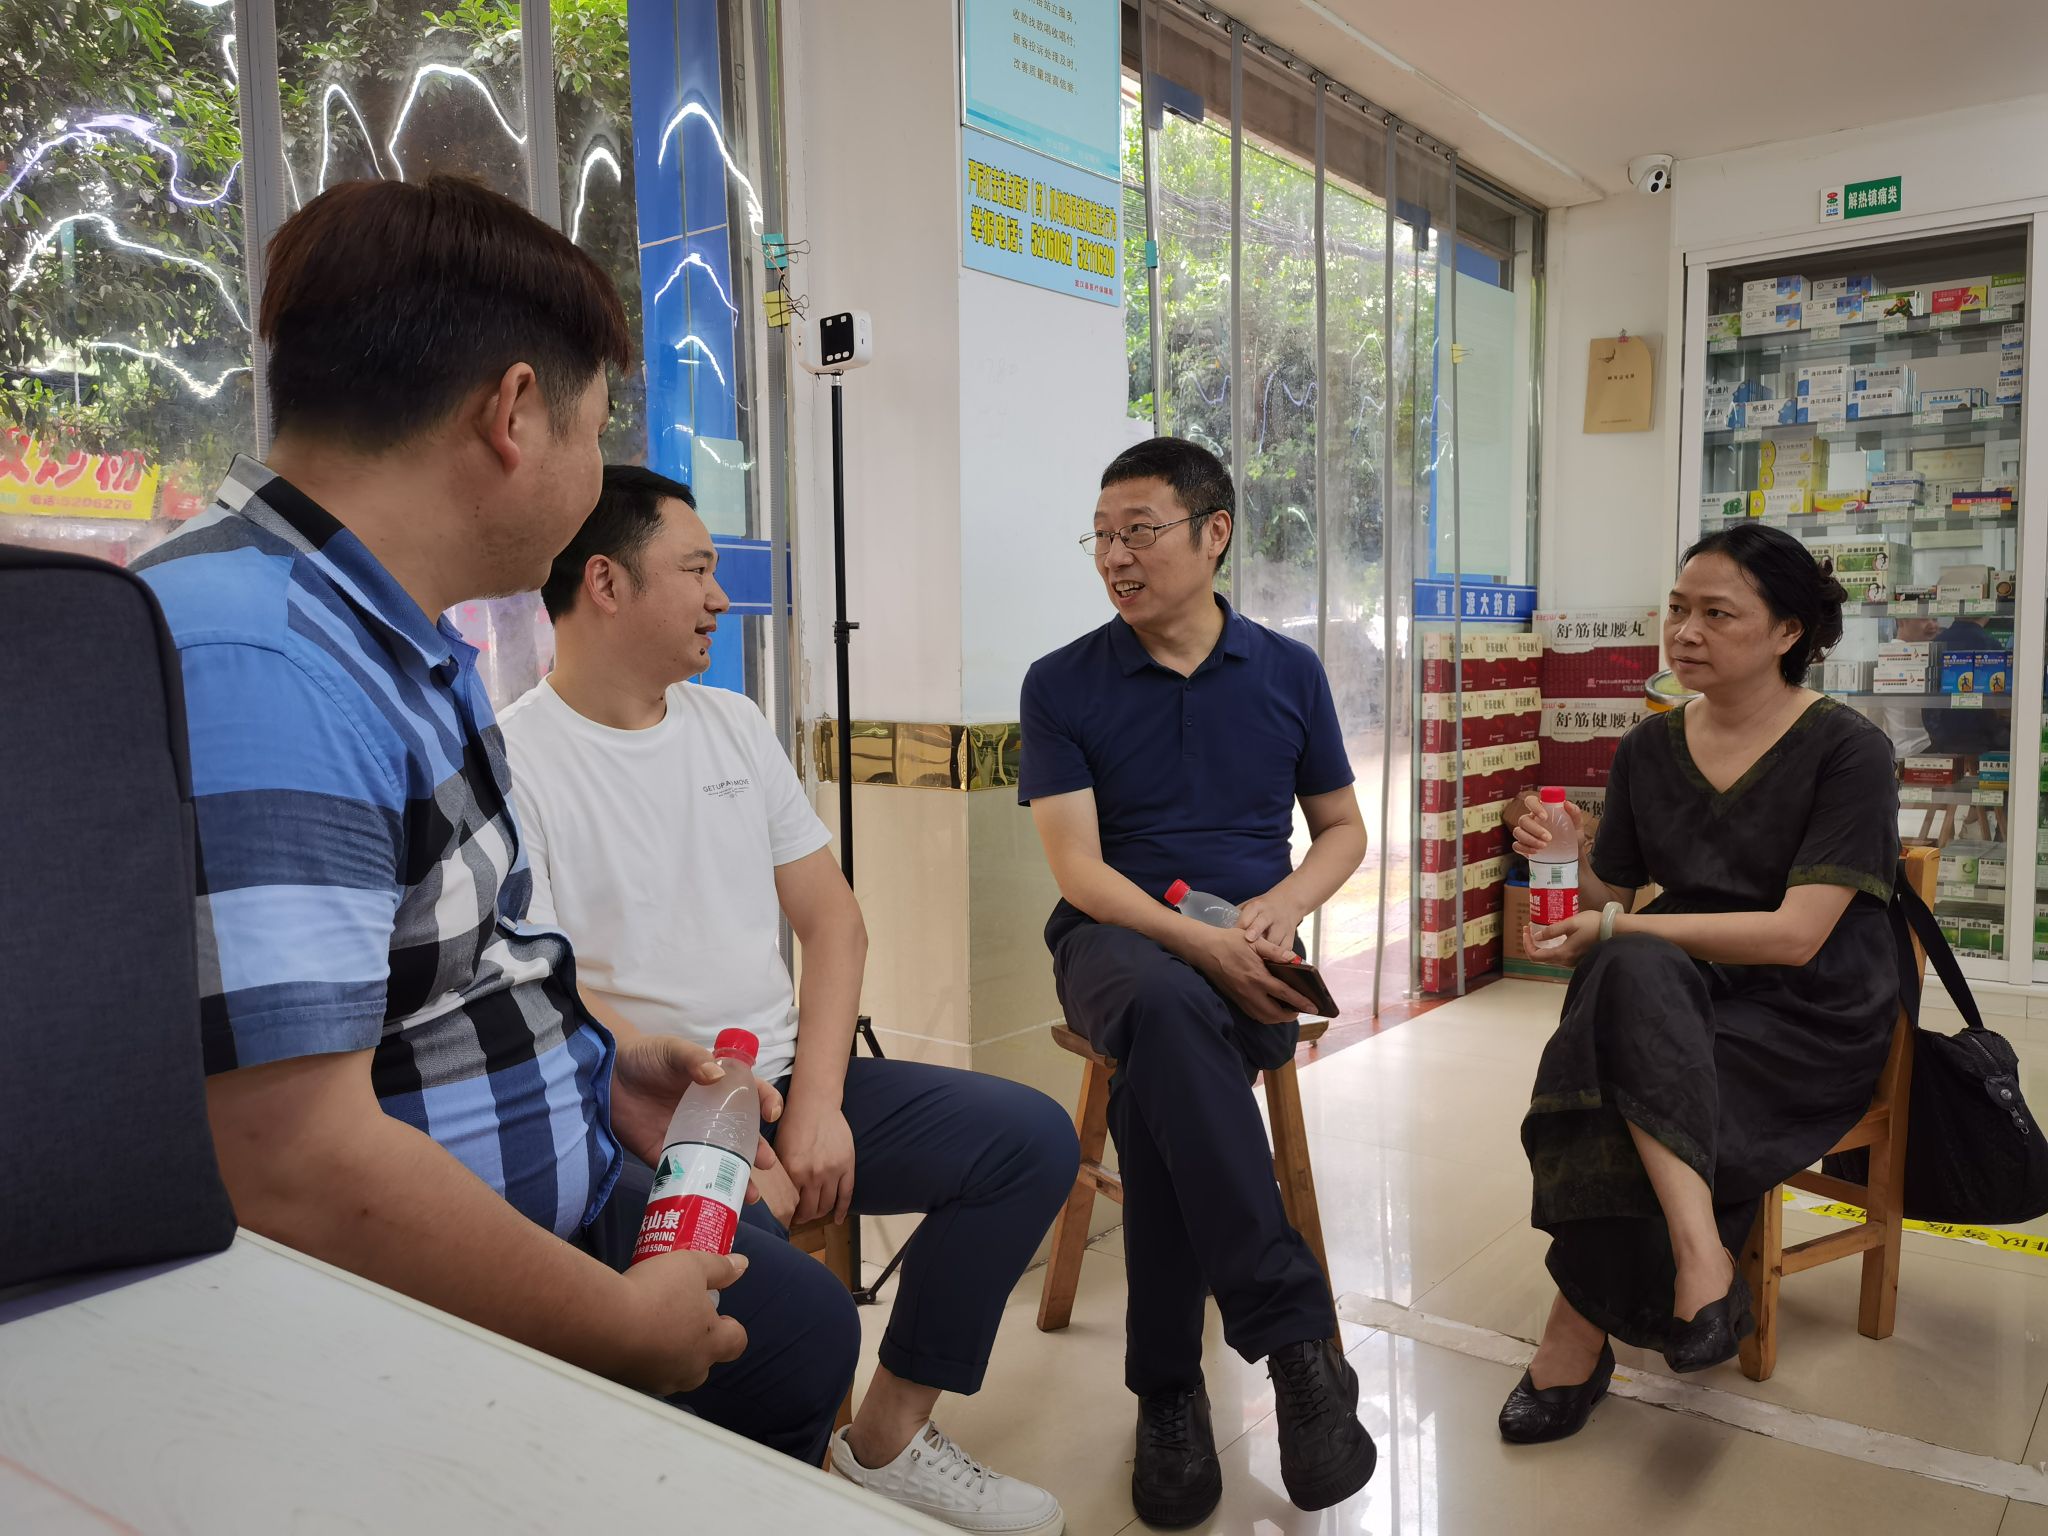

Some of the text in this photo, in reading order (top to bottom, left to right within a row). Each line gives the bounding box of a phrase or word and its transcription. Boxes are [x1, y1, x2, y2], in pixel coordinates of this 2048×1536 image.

[1848, 185, 1898, 210] 解热镇痛类
[1031, 222, 1073, 267] 5216062
[1077, 236, 1115, 279] 5211620
[1436, 589, 1516, 616] 福源大药房
[1556, 621, 1645, 639] 舒筋健腰丸
[643, 1231, 676, 1243] SPRING
